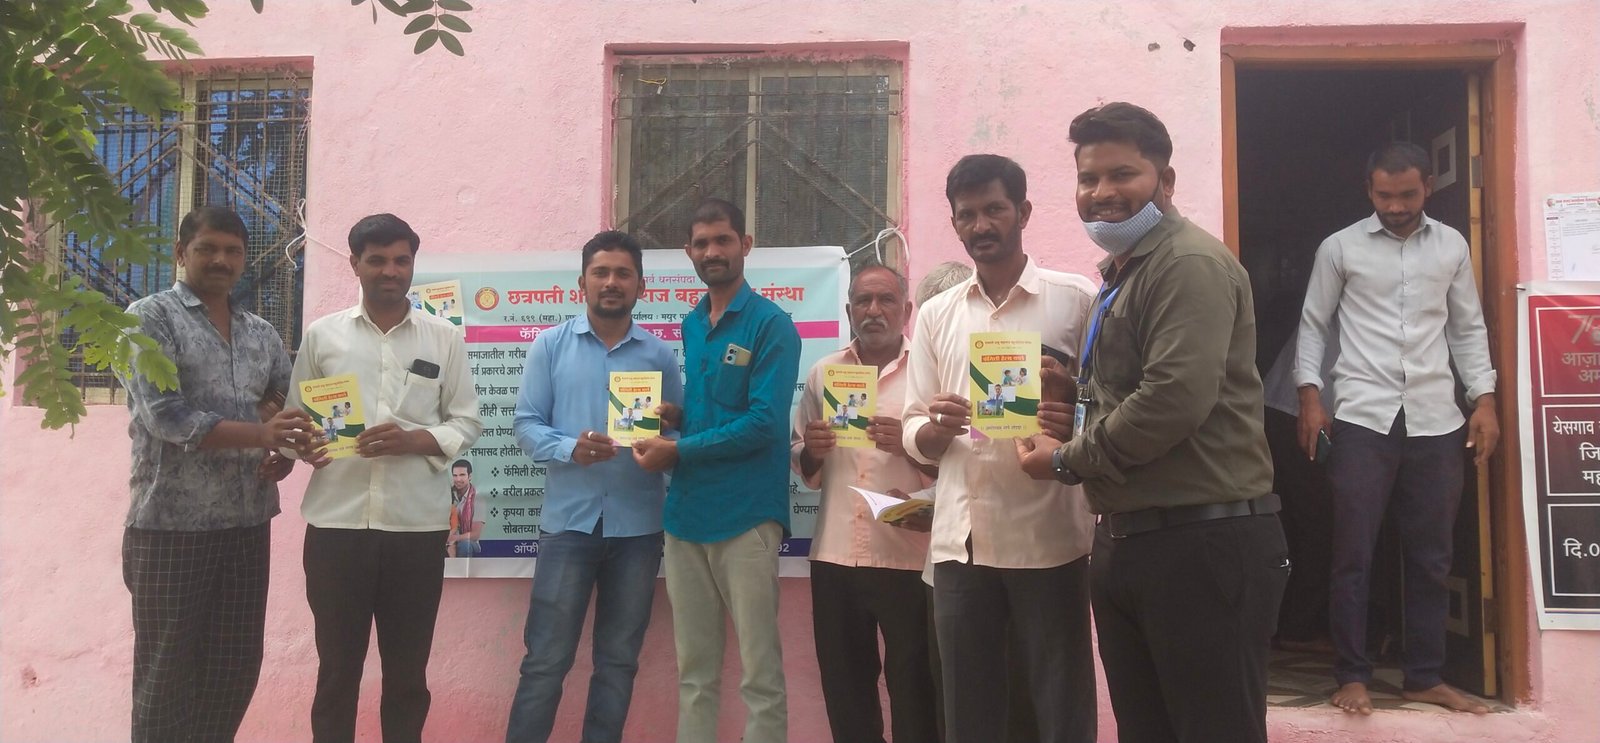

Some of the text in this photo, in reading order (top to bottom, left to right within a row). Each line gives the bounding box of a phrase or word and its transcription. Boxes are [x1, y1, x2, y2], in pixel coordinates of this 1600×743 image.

[508, 285, 565, 304] छत्रपती
[761, 282, 805, 302] संस्था
[1552, 415, 1595, 435] येसगाव
[503, 464, 529, 477] फॅमिली
[502, 484, 522, 497] वरील
[502, 507, 525, 520] कृपया
